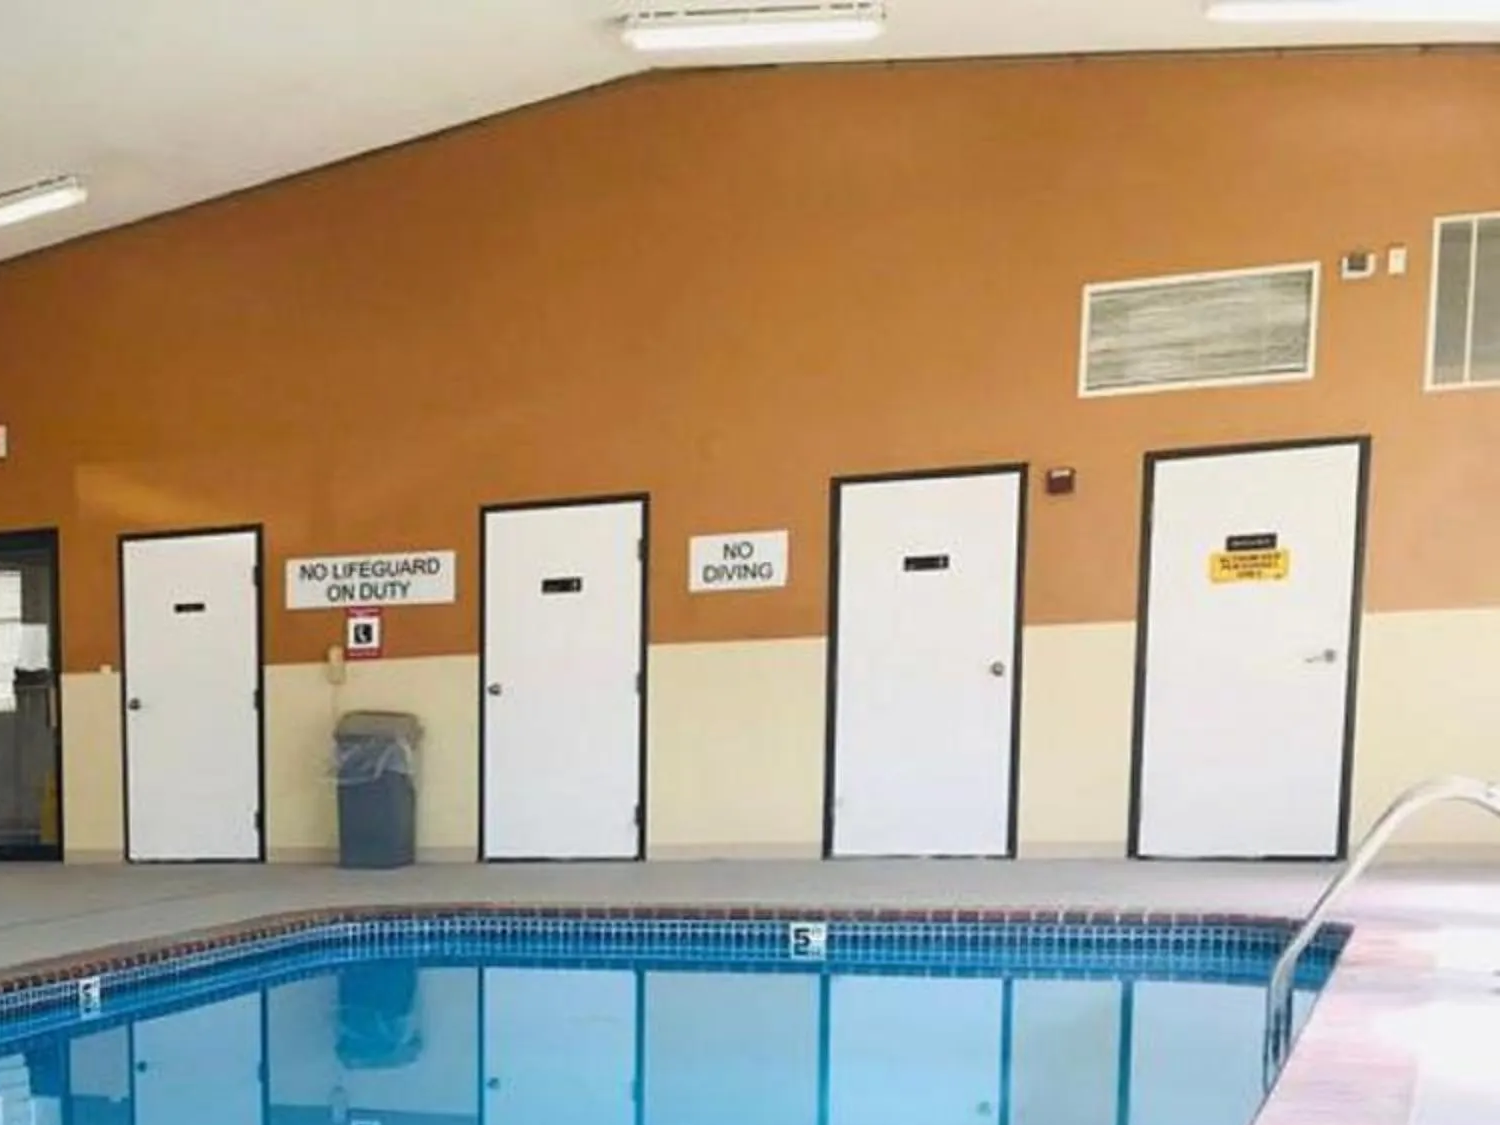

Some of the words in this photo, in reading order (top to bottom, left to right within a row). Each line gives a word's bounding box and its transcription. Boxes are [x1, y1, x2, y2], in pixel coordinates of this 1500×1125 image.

[723, 541, 754, 560] NO
[299, 563, 328, 582] NO
[332, 557, 441, 580] LIFEGUARD
[702, 561, 774, 584] DIVING
[327, 584, 355, 602] ON
[359, 581, 411, 601] DUTY
[794, 927, 811, 948] 5
